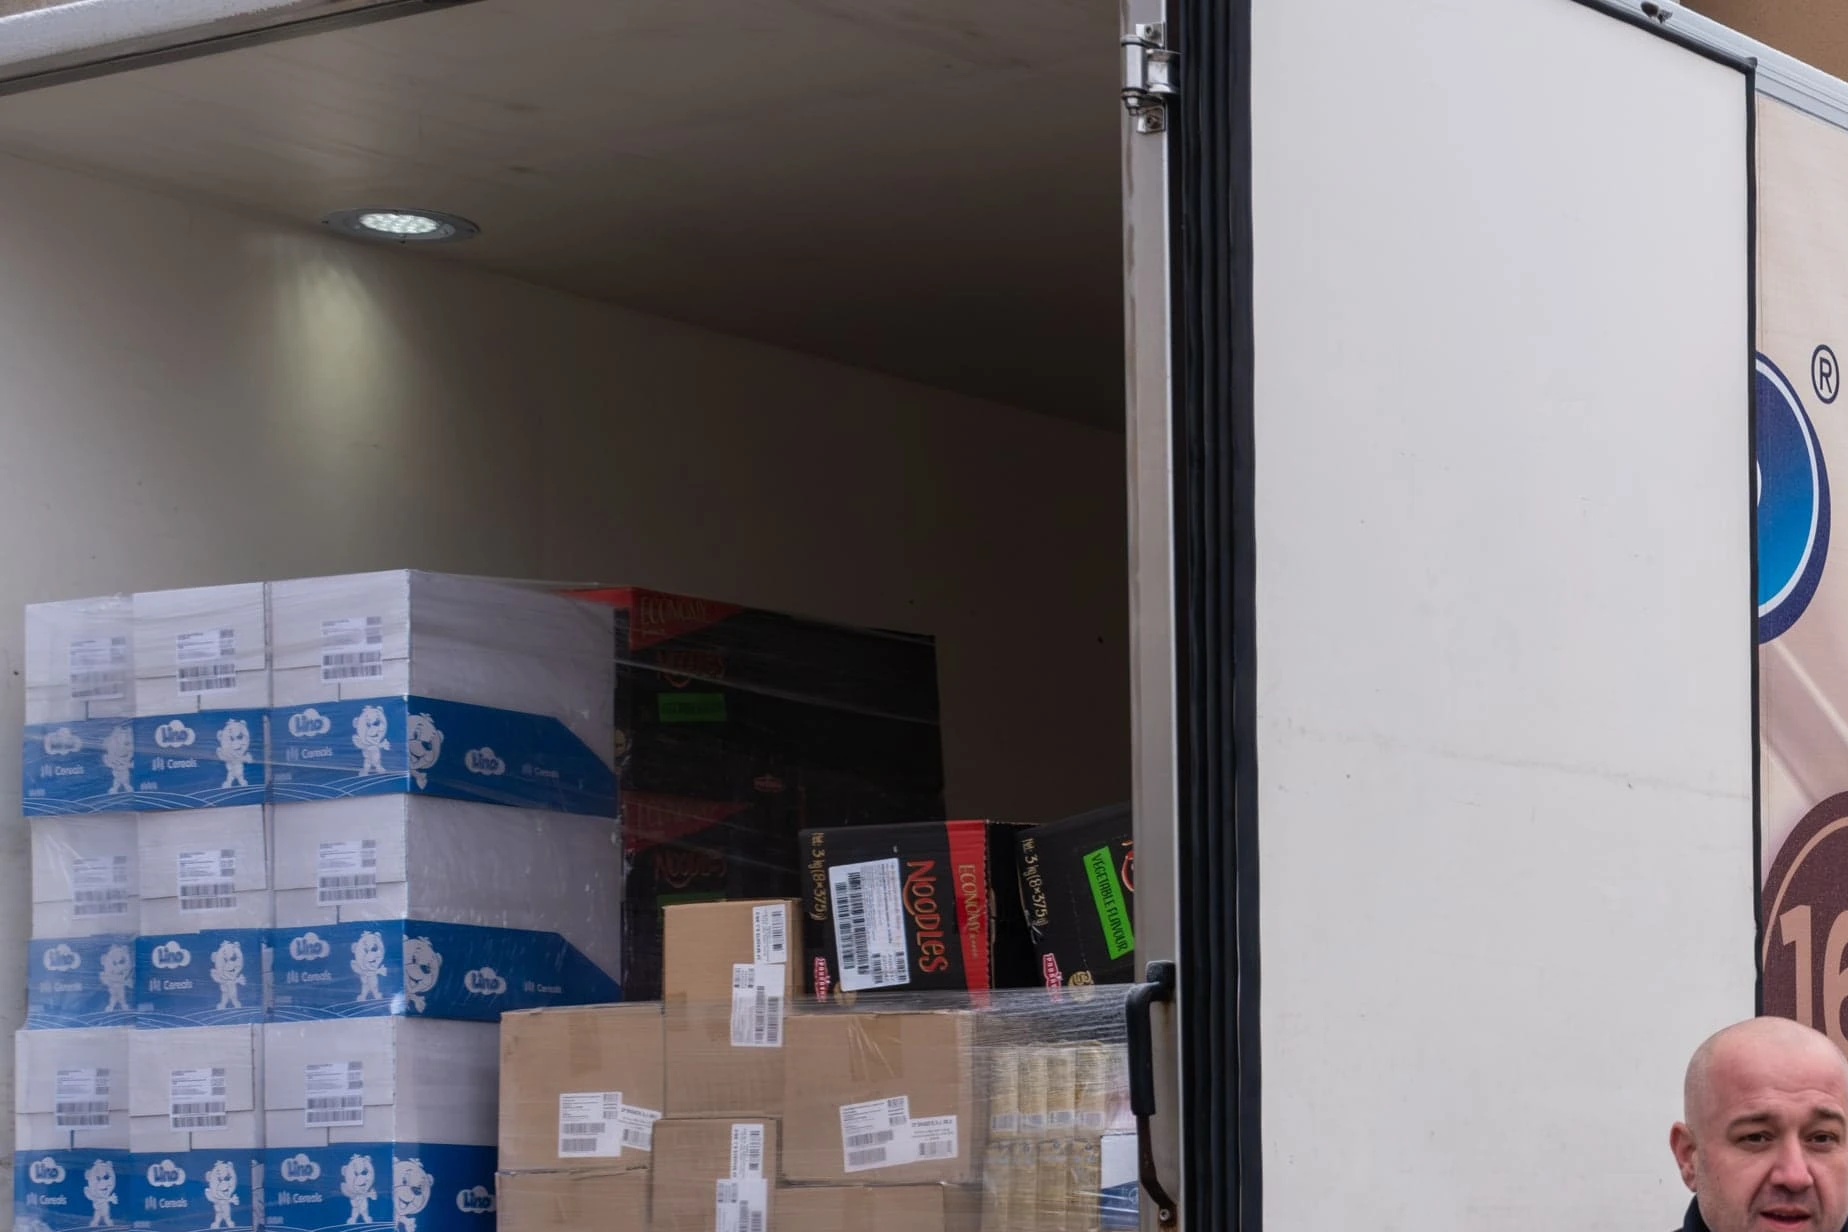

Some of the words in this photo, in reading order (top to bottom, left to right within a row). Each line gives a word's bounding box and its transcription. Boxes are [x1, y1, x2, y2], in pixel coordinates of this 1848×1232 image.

[957, 864, 983, 933] ECONOMY
[1091, 853, 1117, 907] VEGETABLE
[1105, 907, 1128, 952] FLAVOUR
